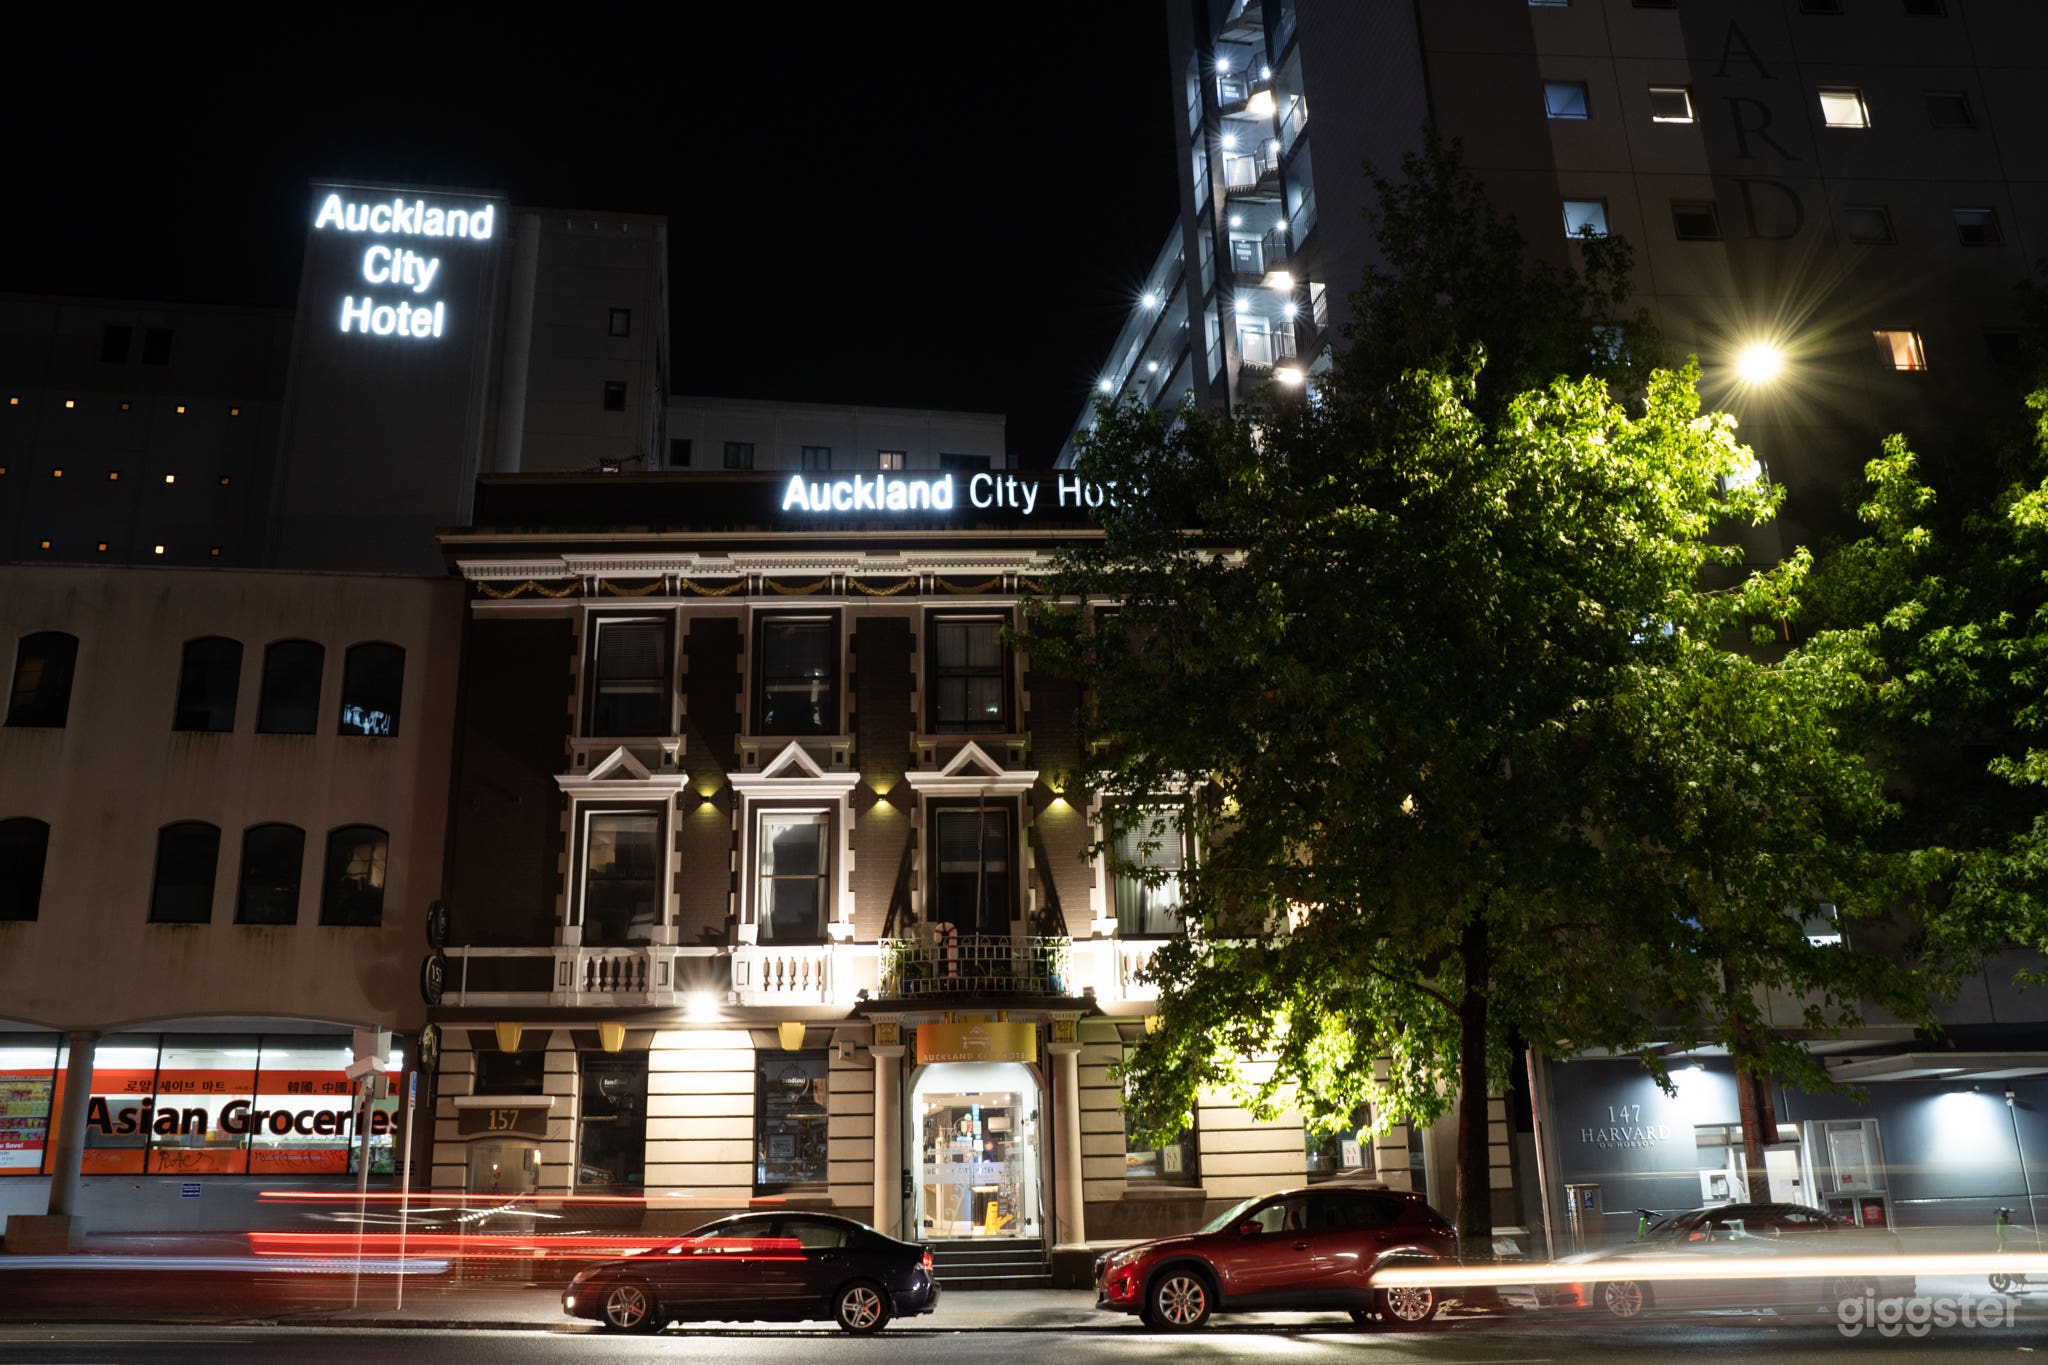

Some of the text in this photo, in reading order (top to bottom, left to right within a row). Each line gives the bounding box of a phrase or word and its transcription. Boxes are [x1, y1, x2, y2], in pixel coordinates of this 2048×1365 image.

[315, 193, 495, 240] Auckland
[362, 244, 440, 293] City
[340, 295, 445, 338] Hotel
[782, 472, 953, 511] Auckland
[968, 472, 1040, 515] City
[922, 1051, 974, 1062] AUCKLAND
[202, 1080, 226, 1093] 마트
[86, 1096, 208, 1136] Asian
[488, 1109, 520, 1130] 157
[1608, 1104, 1641, 1123] 147
[1580, 1125, 1671, 1143] HARVARD
[1599, 1142, 1613, 1150] ON
[1584, 1192, 1592, 1200] P
